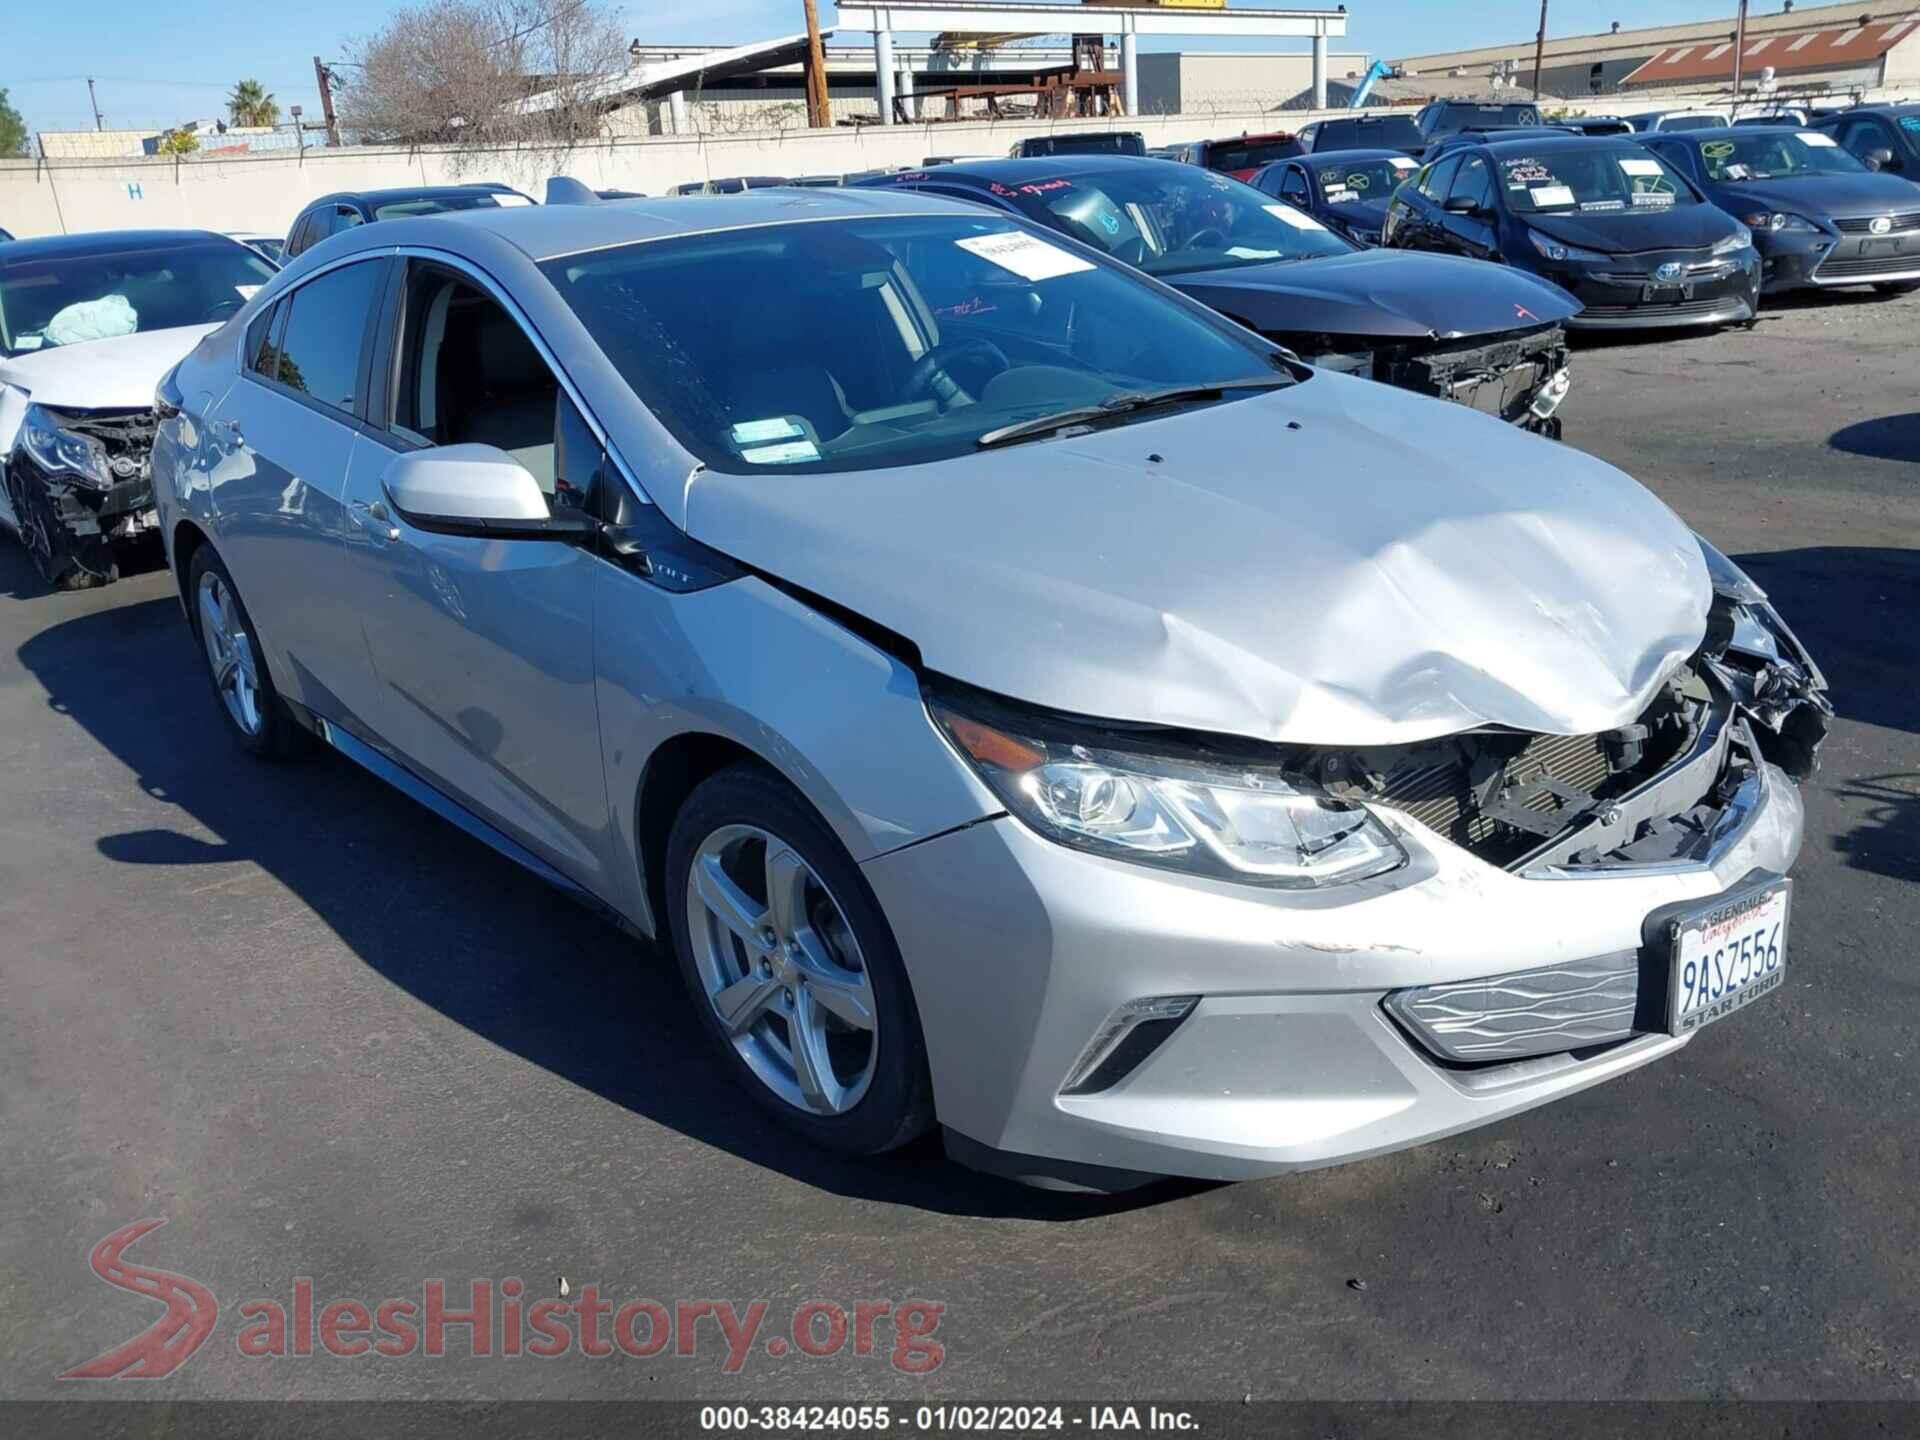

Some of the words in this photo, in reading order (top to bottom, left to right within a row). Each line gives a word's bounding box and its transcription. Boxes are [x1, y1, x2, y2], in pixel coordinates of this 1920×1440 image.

[1681, 998, 1733, 1031] STAR
[1738, 972, 1780, 1005] FORD
[1682, 921, 1780, 1014] 9ASZ556
